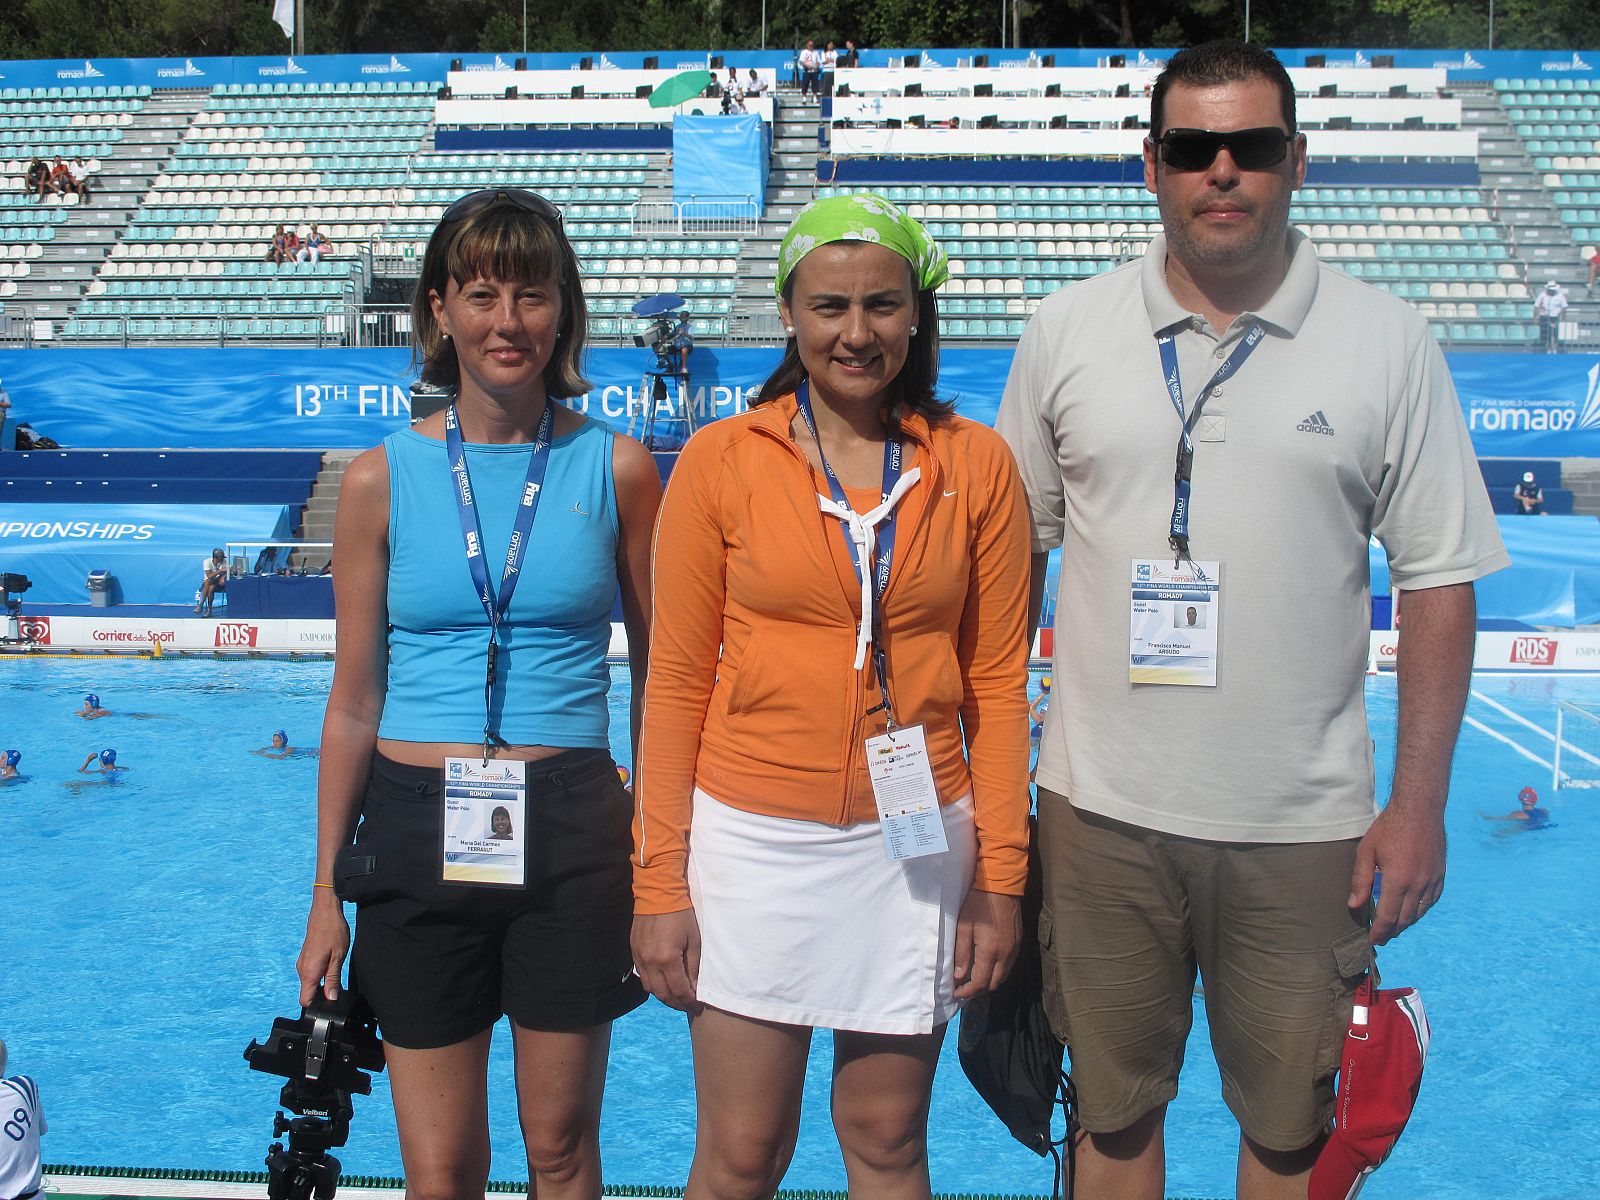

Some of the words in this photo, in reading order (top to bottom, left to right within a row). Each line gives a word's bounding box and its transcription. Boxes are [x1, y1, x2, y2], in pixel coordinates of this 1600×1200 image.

[295, 384, 348, 417] 13TH
[358, 385, 411, 417] FIN
[602, 385, 757, 418] CHAMPI
[1296, 423, 1335, 437] adidas
[1469, 408, 1576, 431] roma09
[460, 471, 473, 506] roma09
[507, 530, 521, 565] roma09
[92, 629, 133, 641] Corriere
[147, 630, 175, 646] Sport
[219, 624, 250, 645] RDS
[1515, 638, 1549, 660] RDS
[469, 790, 493, 798] ROMA09
[302, 1108, 328, 1116] Velbon
[4, 1107, 31, 1141] 09
